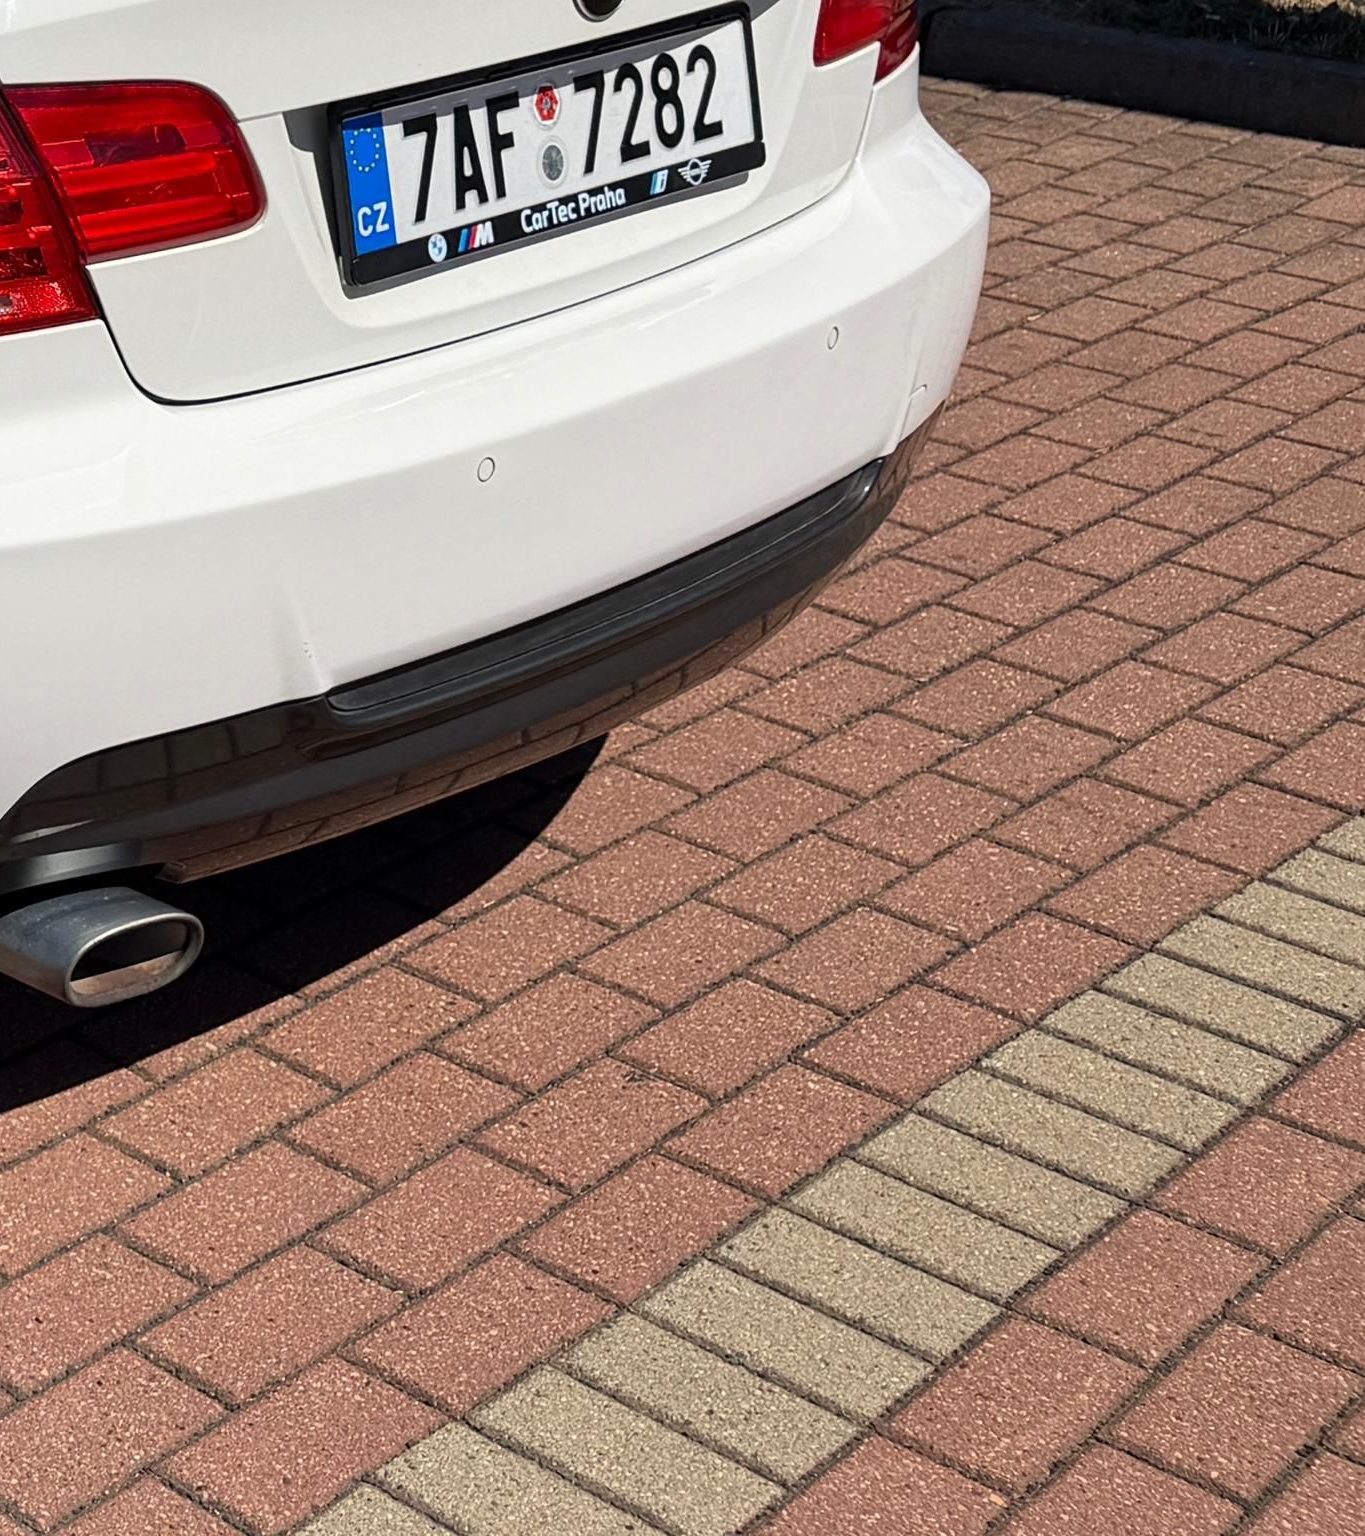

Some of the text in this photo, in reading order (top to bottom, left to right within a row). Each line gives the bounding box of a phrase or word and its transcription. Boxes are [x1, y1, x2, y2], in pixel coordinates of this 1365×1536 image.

[401, 44, 723, 225] 7AF 7282
[357, 201, 390, 237] CZ
[520, 185, 627, 234] CarTec Praha
